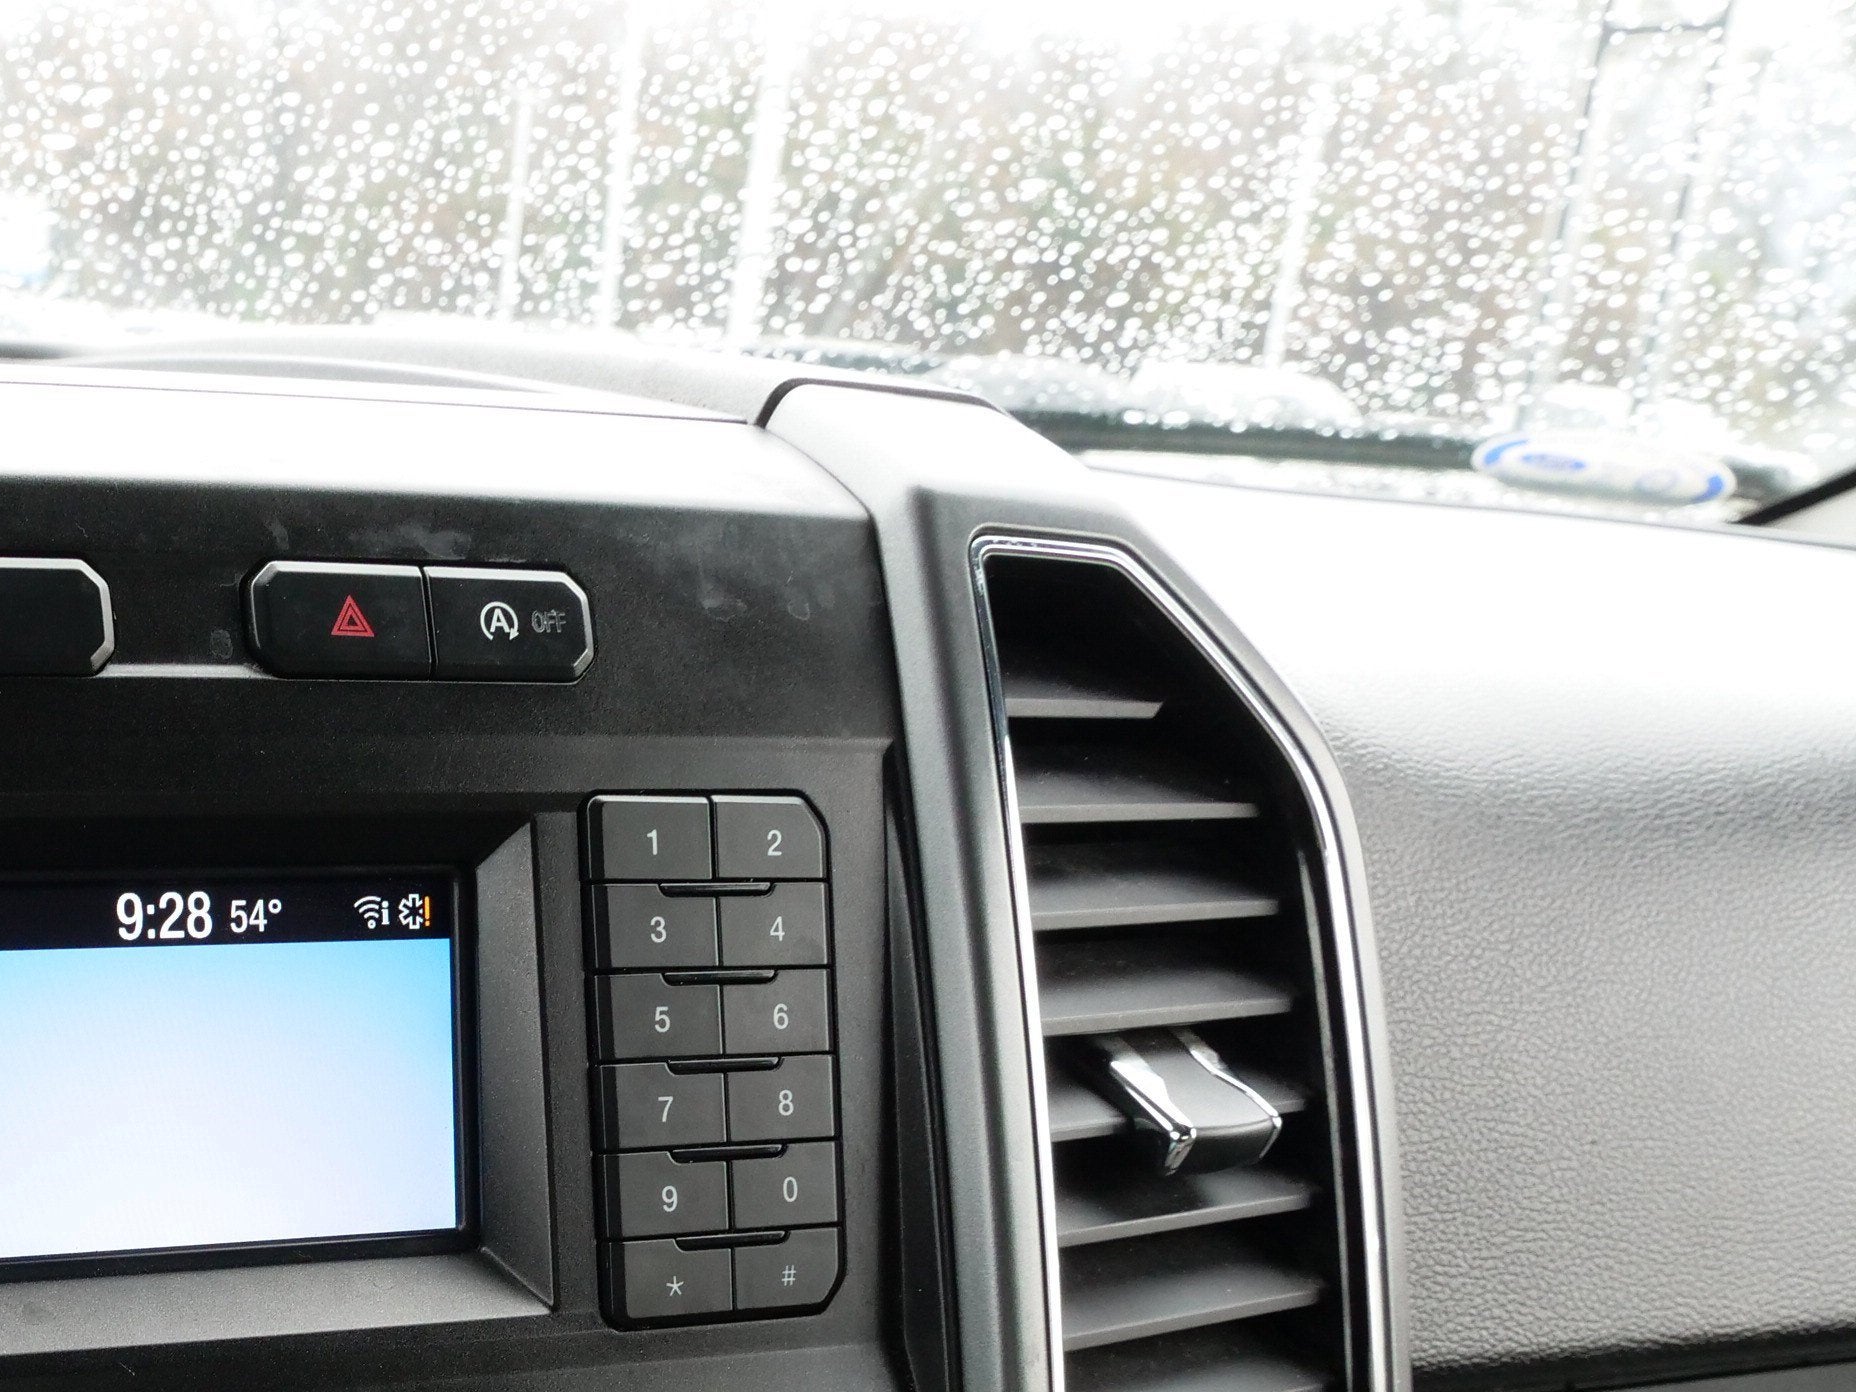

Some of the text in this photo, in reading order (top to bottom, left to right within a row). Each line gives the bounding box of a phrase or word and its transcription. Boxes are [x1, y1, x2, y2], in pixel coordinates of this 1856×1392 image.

[489, 607, 567, 634] A OFF
[646, 829, 783, 856] 1 2
[116, 890, 282, 941] 9:28 54°
[650, 915, 786, 944] 3 4
[654, 1003, 789, 1033] 5 6
[657, 1089, 794, 1123] 7 8
[661, 1176, 798, 1213] 9 0
